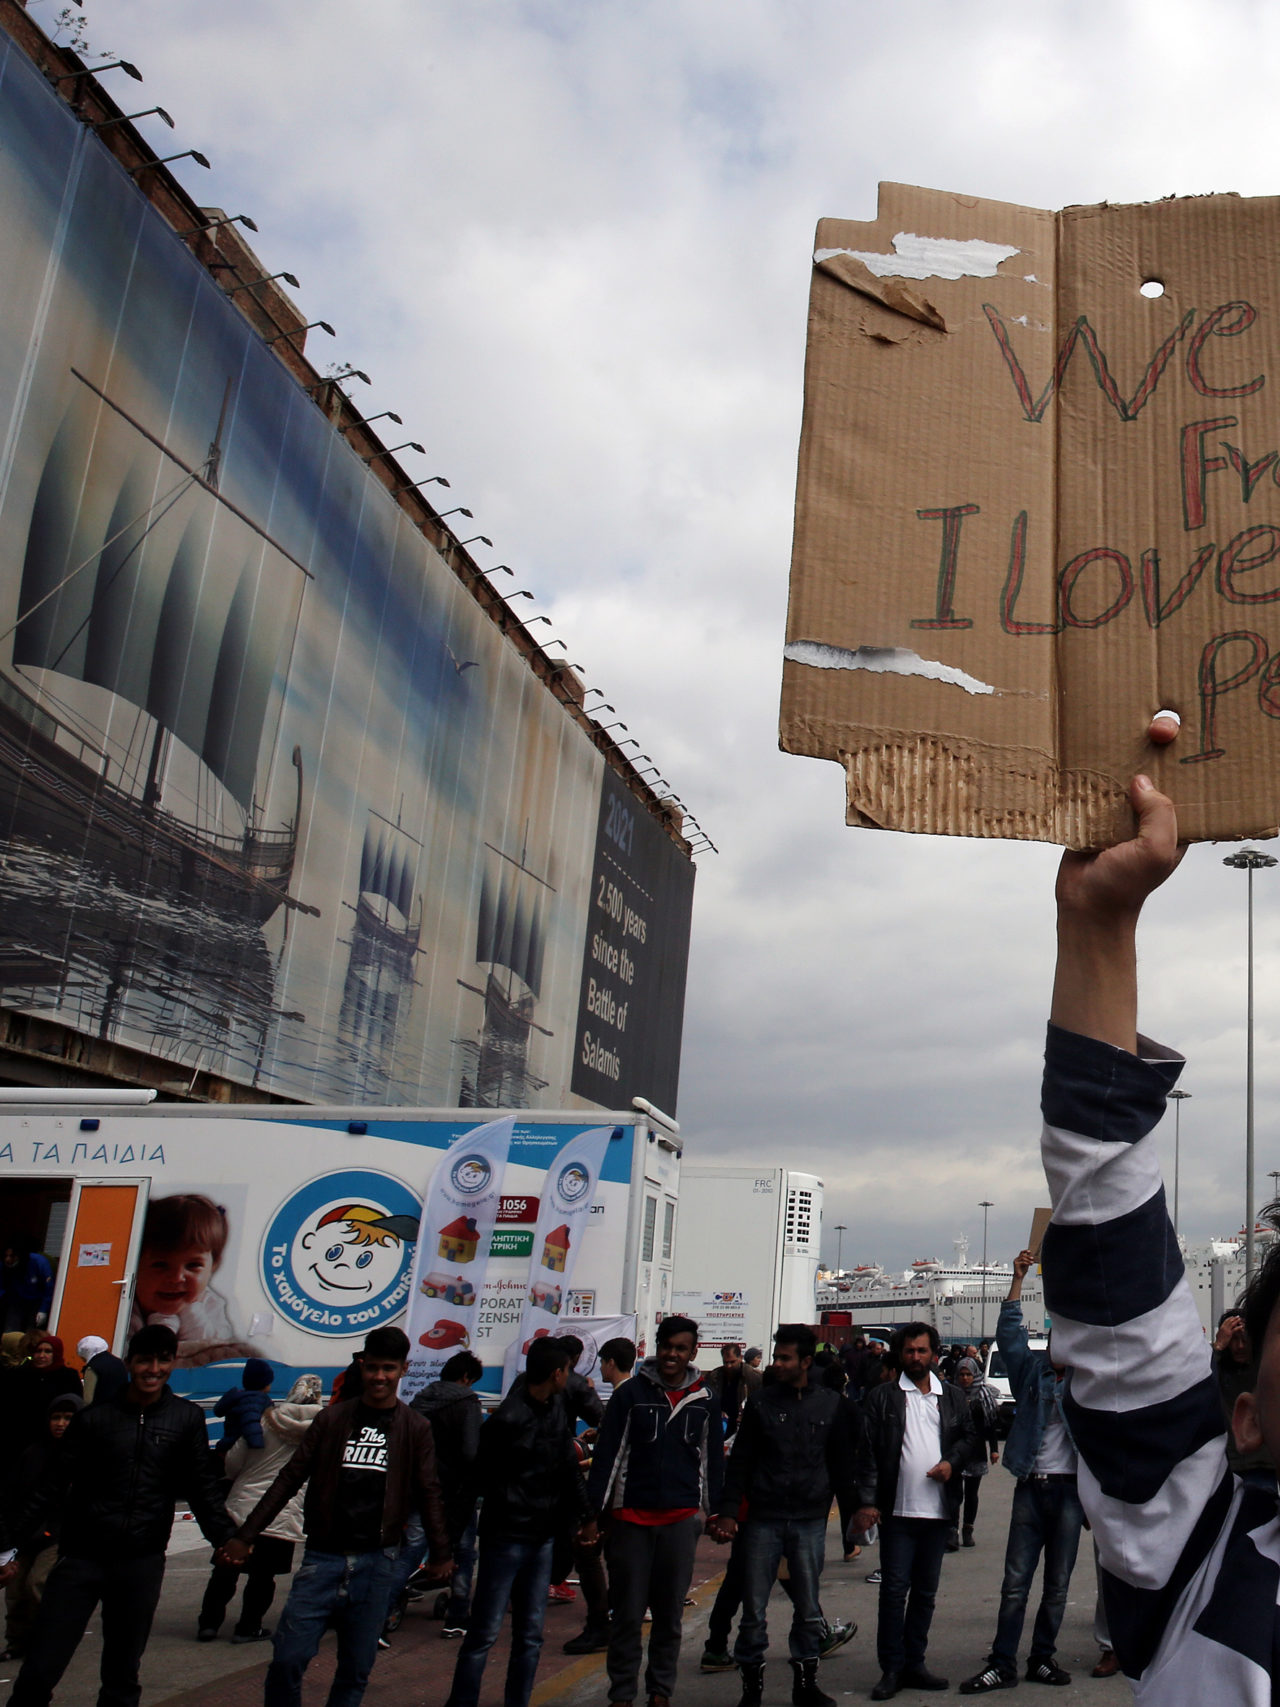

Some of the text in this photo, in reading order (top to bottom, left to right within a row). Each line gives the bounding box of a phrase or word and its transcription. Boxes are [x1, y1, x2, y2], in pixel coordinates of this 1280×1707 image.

[983, 300, 1265, 423] We
[910, 503, 980, 630] I
[604, 792, 636, 858] 2021
[597, 874, 647, 945] 2.500 years
[592, 931, 635, 985] since the
[587, 977, 627, 1033] Battle of
[582, 1030, 620, 1081] Salamis
[32, 1142, 60, 1164] ΤΑ
[71, 1142, 166, 1165] ΠΑΙΔΙΑ
[502, 1199, 527, 1211] 1056
[754, 1179, 772, 1188] FRC
[271, 1243, 288, 1268] Το
[273, 1271, 343, 1326] χαμόγελο
[346, 1306, 381, 1325] του
[359, 1426, 387, 1446] The
